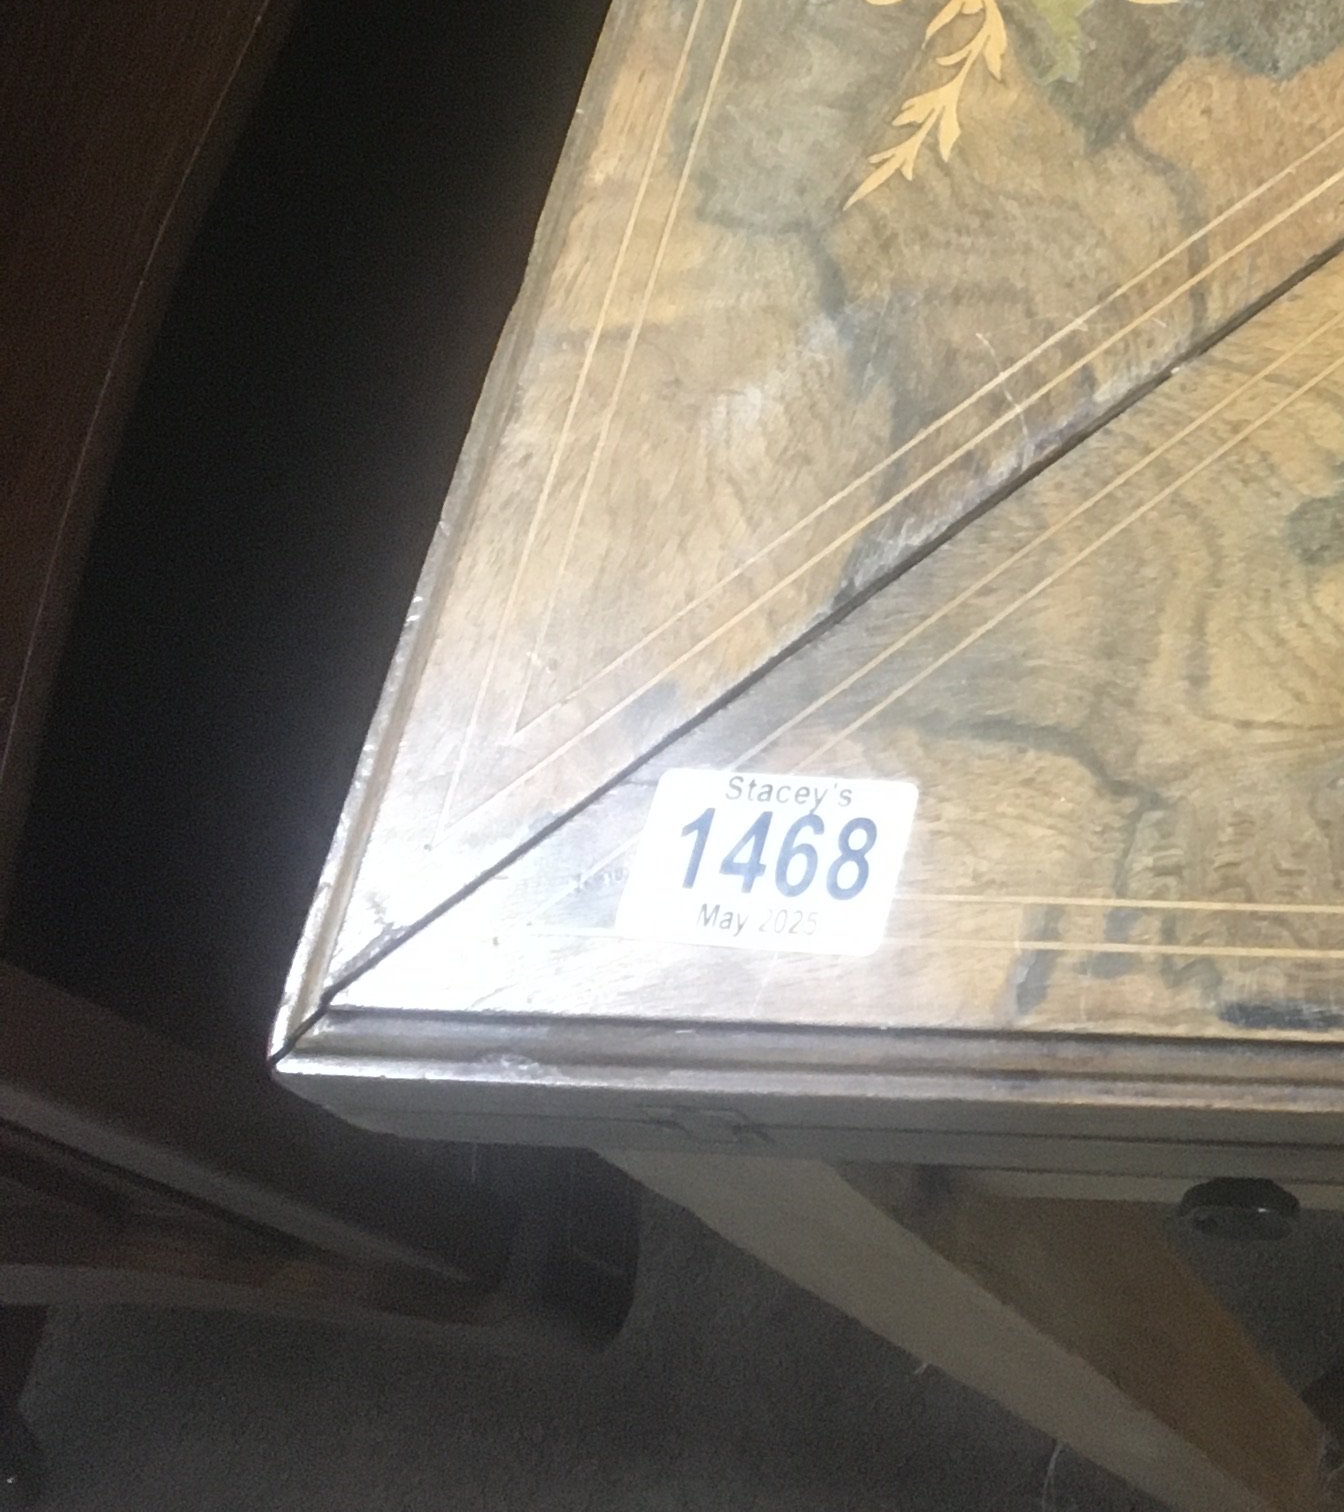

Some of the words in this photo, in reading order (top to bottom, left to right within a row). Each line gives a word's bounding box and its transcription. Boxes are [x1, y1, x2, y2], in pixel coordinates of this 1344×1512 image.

[725, 775, 853, 814] Stacey's
[680, 807, 878, 901] 1468
[696, 903, 750, 937] May
[757, 908, 820, 935] 2025
